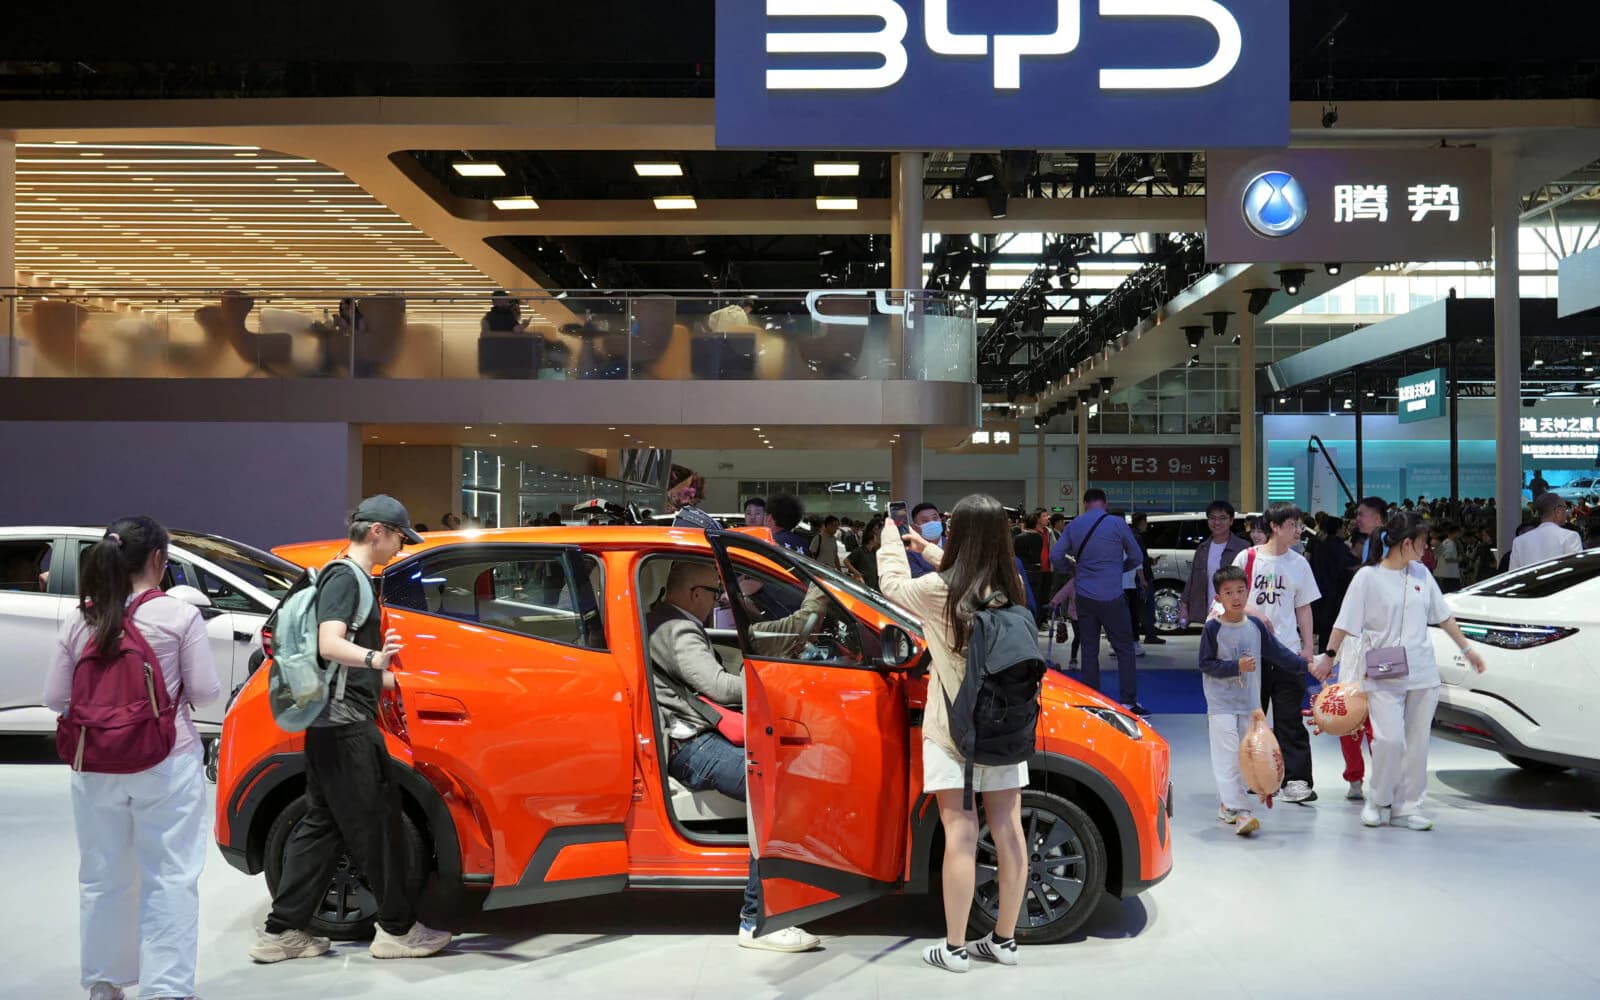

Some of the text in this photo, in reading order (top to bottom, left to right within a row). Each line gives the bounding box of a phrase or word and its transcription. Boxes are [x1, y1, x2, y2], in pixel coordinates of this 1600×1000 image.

[766, 0, 1242, 89] BYD
[1334, 184, 1460, 222] 腾势
[1540, 417, 1593, 432] 天神之眼
[1110, 455, 1128, 465] W3
[1131, 457, 1158, 473] E3
[1168, 457, 1181, 474] 9
[1255, 591, 1282, 608] OUT
